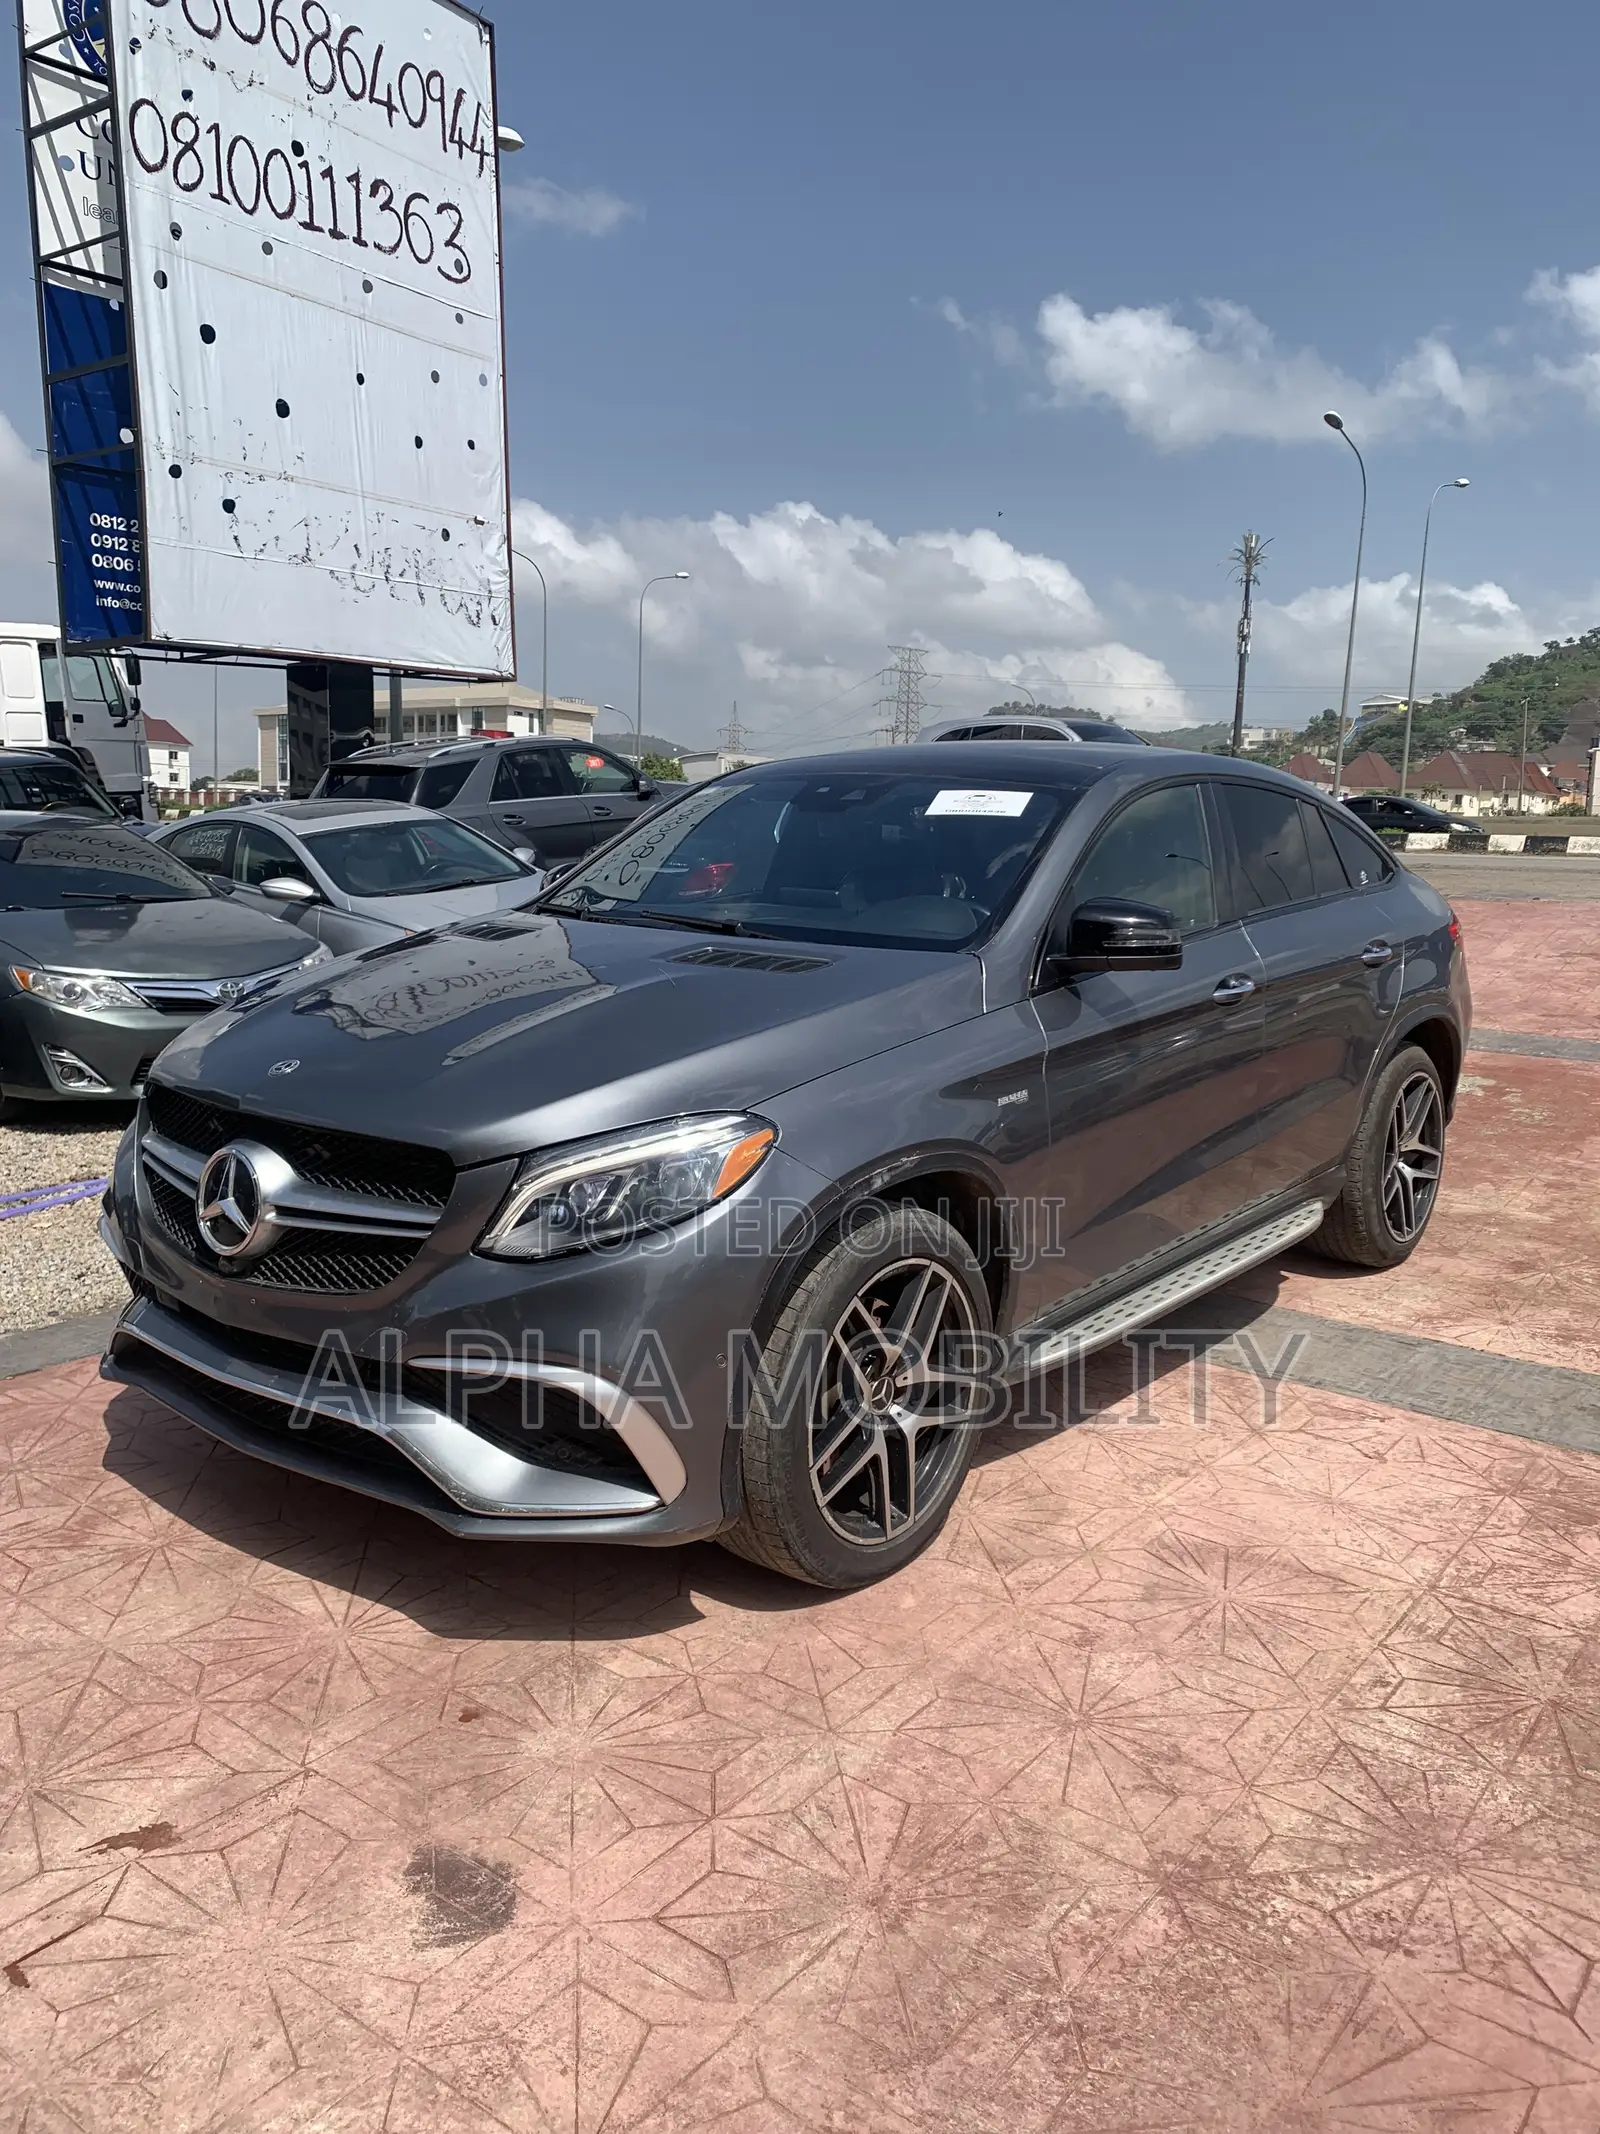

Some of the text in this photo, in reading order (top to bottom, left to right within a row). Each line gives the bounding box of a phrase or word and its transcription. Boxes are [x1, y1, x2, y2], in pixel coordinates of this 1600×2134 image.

[129, 97, 472, 284] 08100111363
[89, 512, 128, 532] 0812
[90, 533, 129, 552] 0912
[91, 553, 134, 572] 0806
